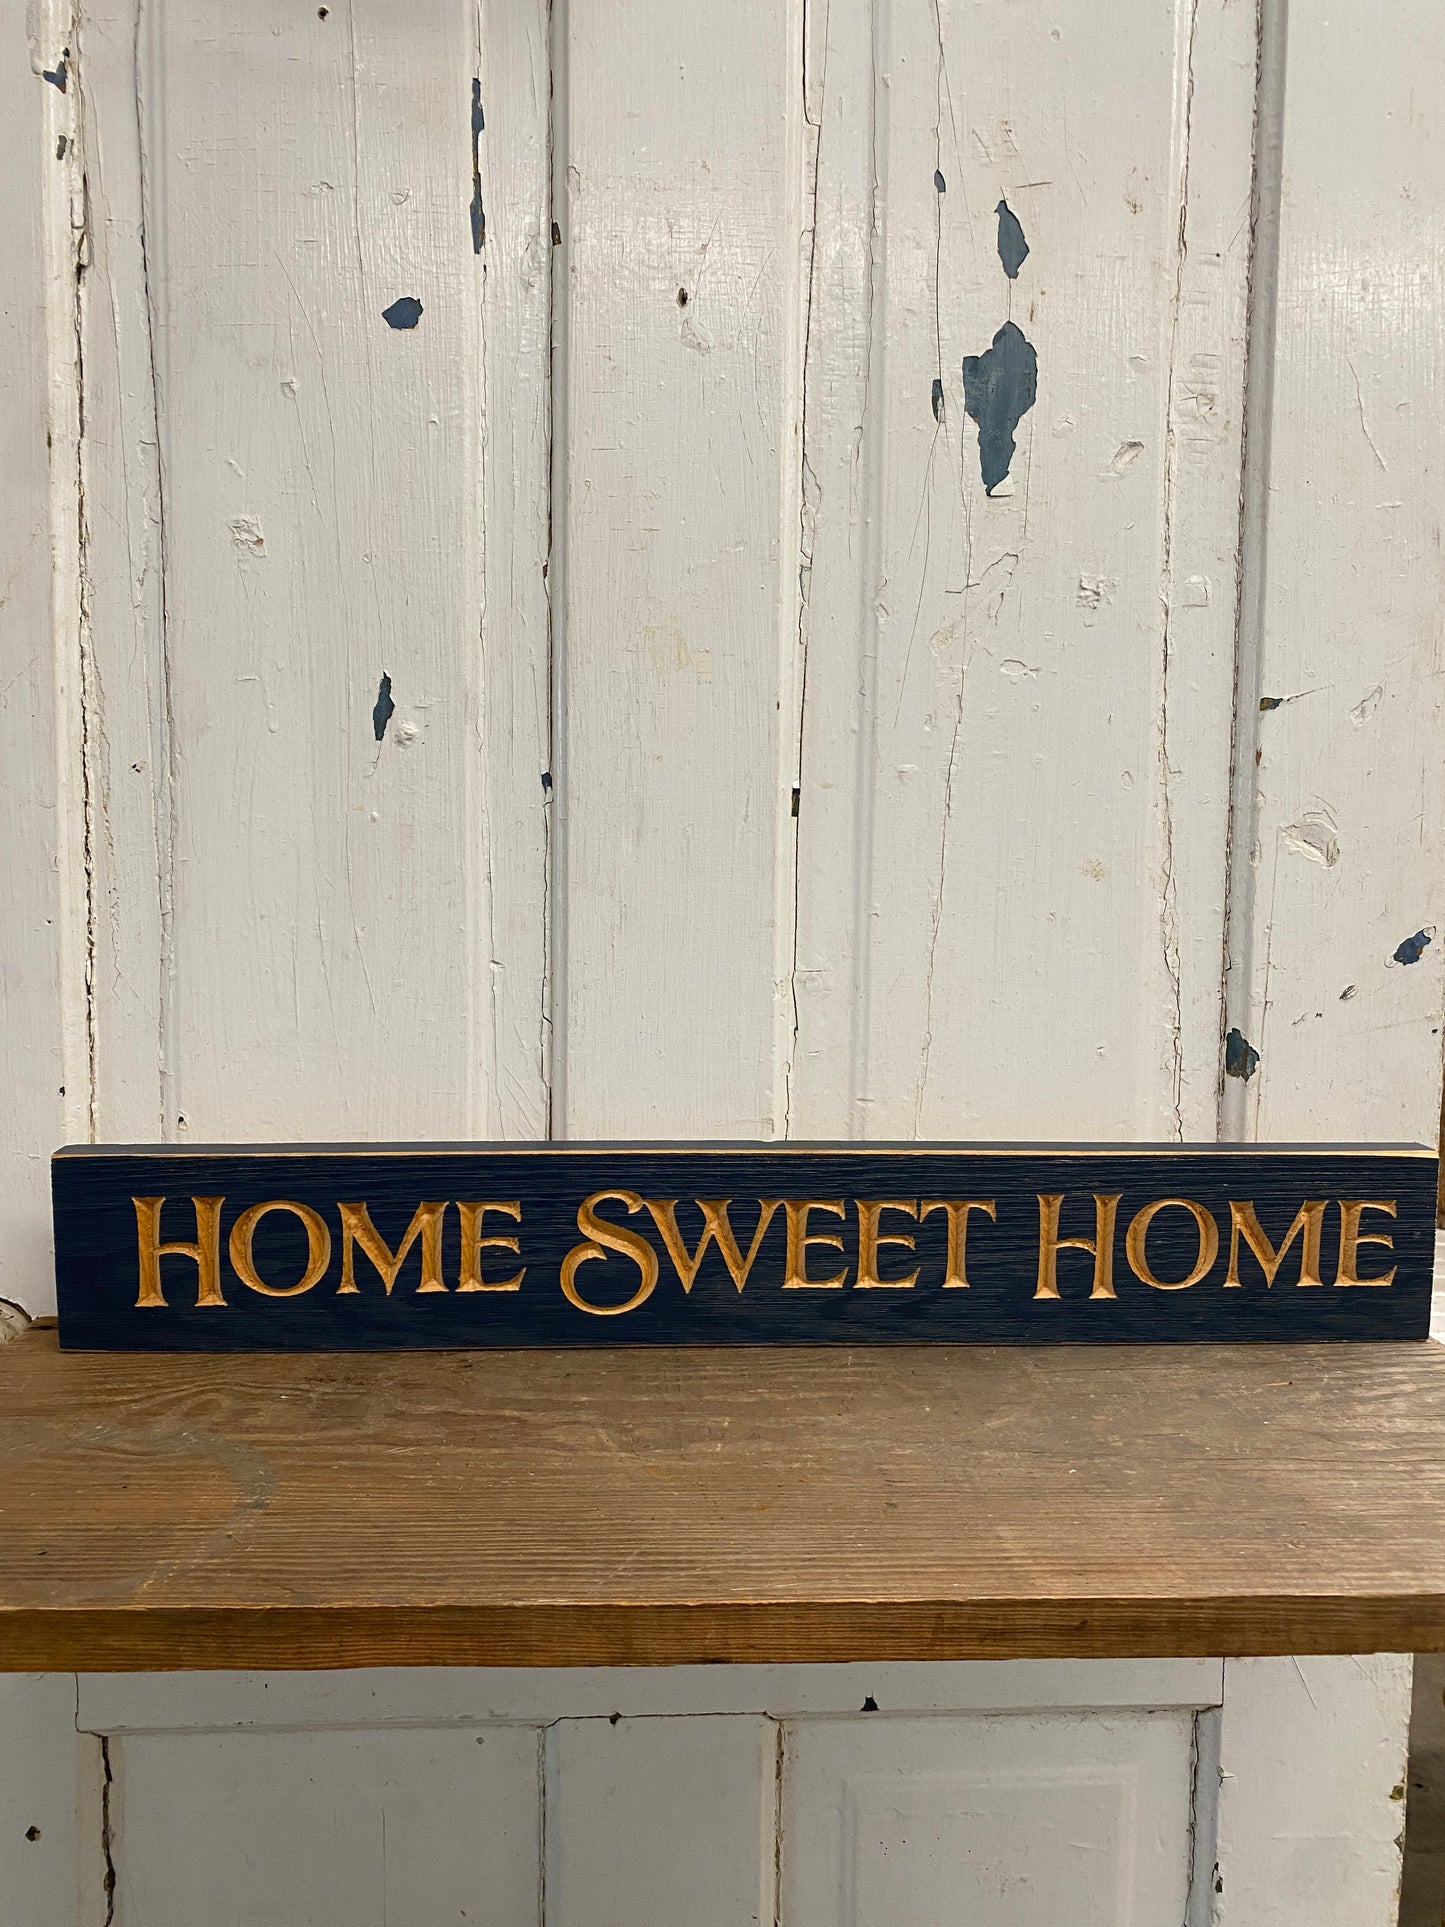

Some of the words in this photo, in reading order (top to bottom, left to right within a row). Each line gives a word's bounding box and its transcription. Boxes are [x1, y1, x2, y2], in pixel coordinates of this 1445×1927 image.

[131, 1196, 527, 1307] HOME
[559, 1188, 996, 1316] SWEET
[1033, 1193, 1399, 1299] HOME
